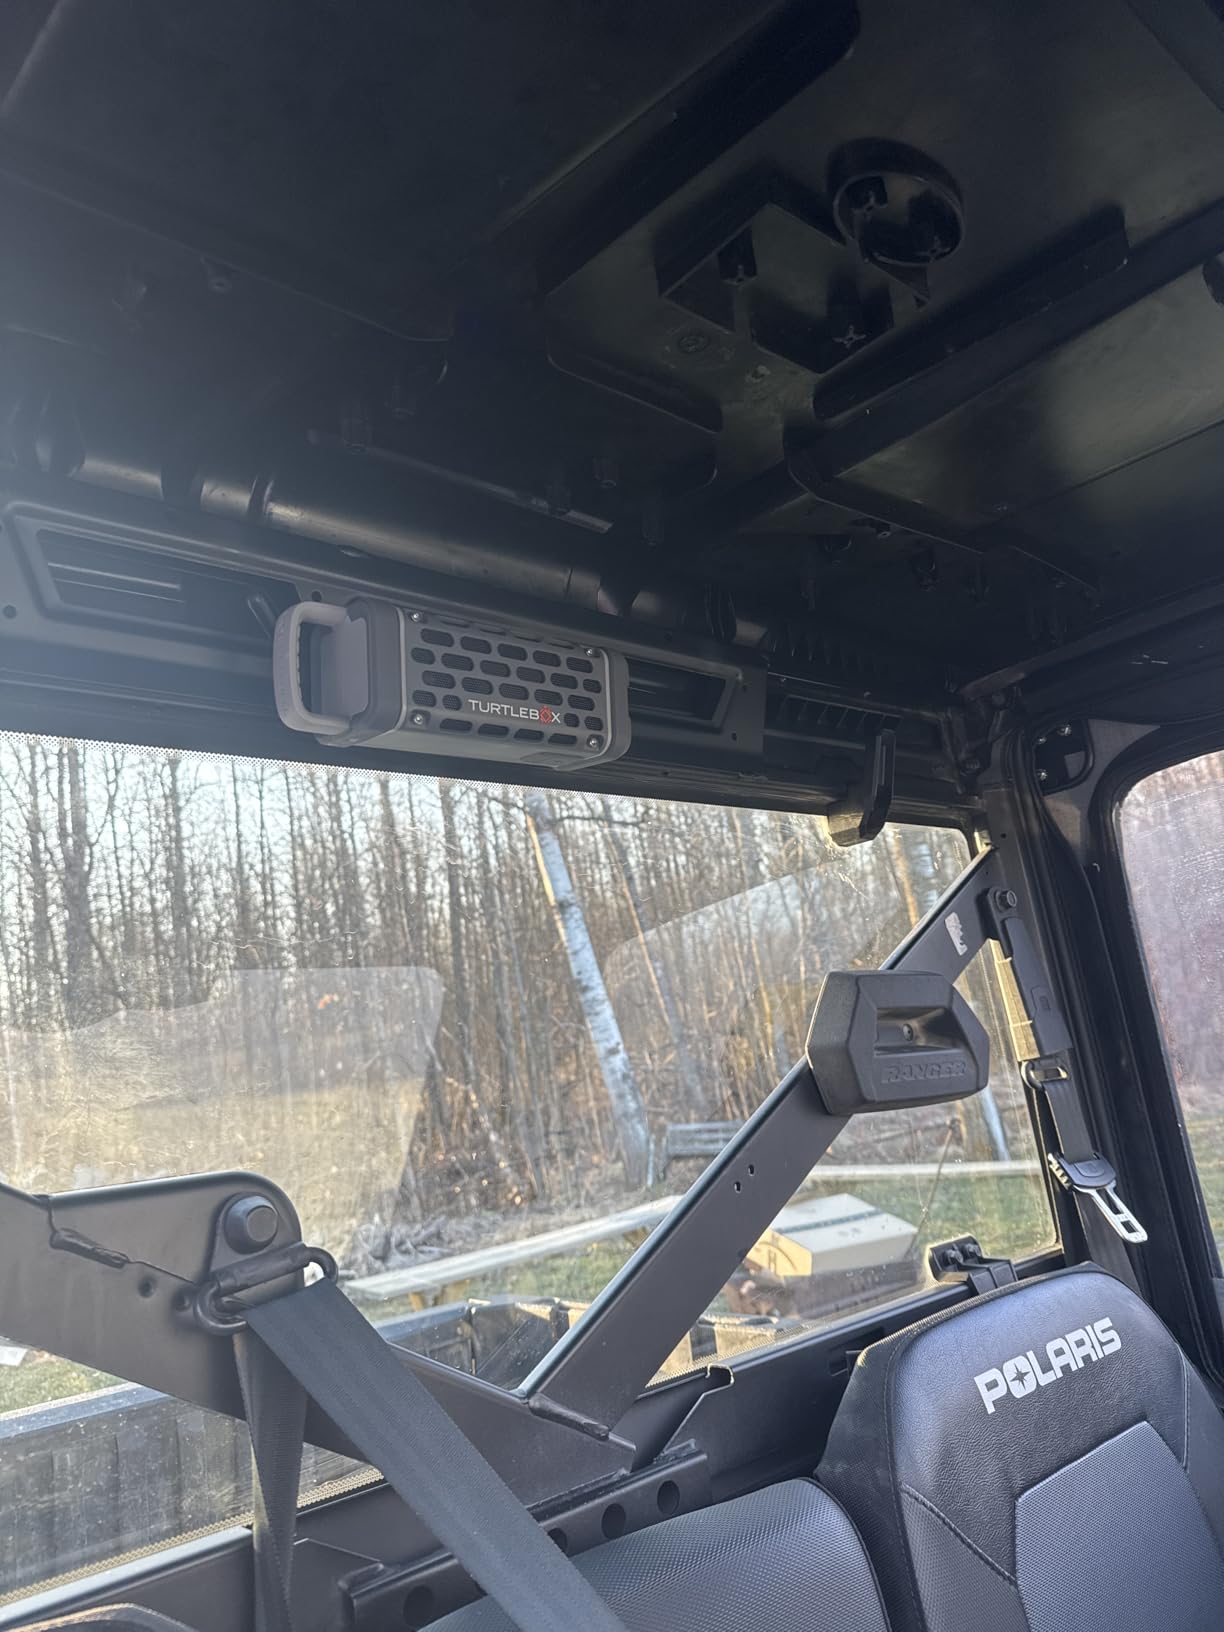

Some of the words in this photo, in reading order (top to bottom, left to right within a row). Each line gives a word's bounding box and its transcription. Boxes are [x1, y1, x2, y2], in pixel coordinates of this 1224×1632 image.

[468, 699, 561, 724] TURTLEBOX
[881, 1061, 966, 1084] RANGER
[973, 1316, 1122, 1415] POLARIS
